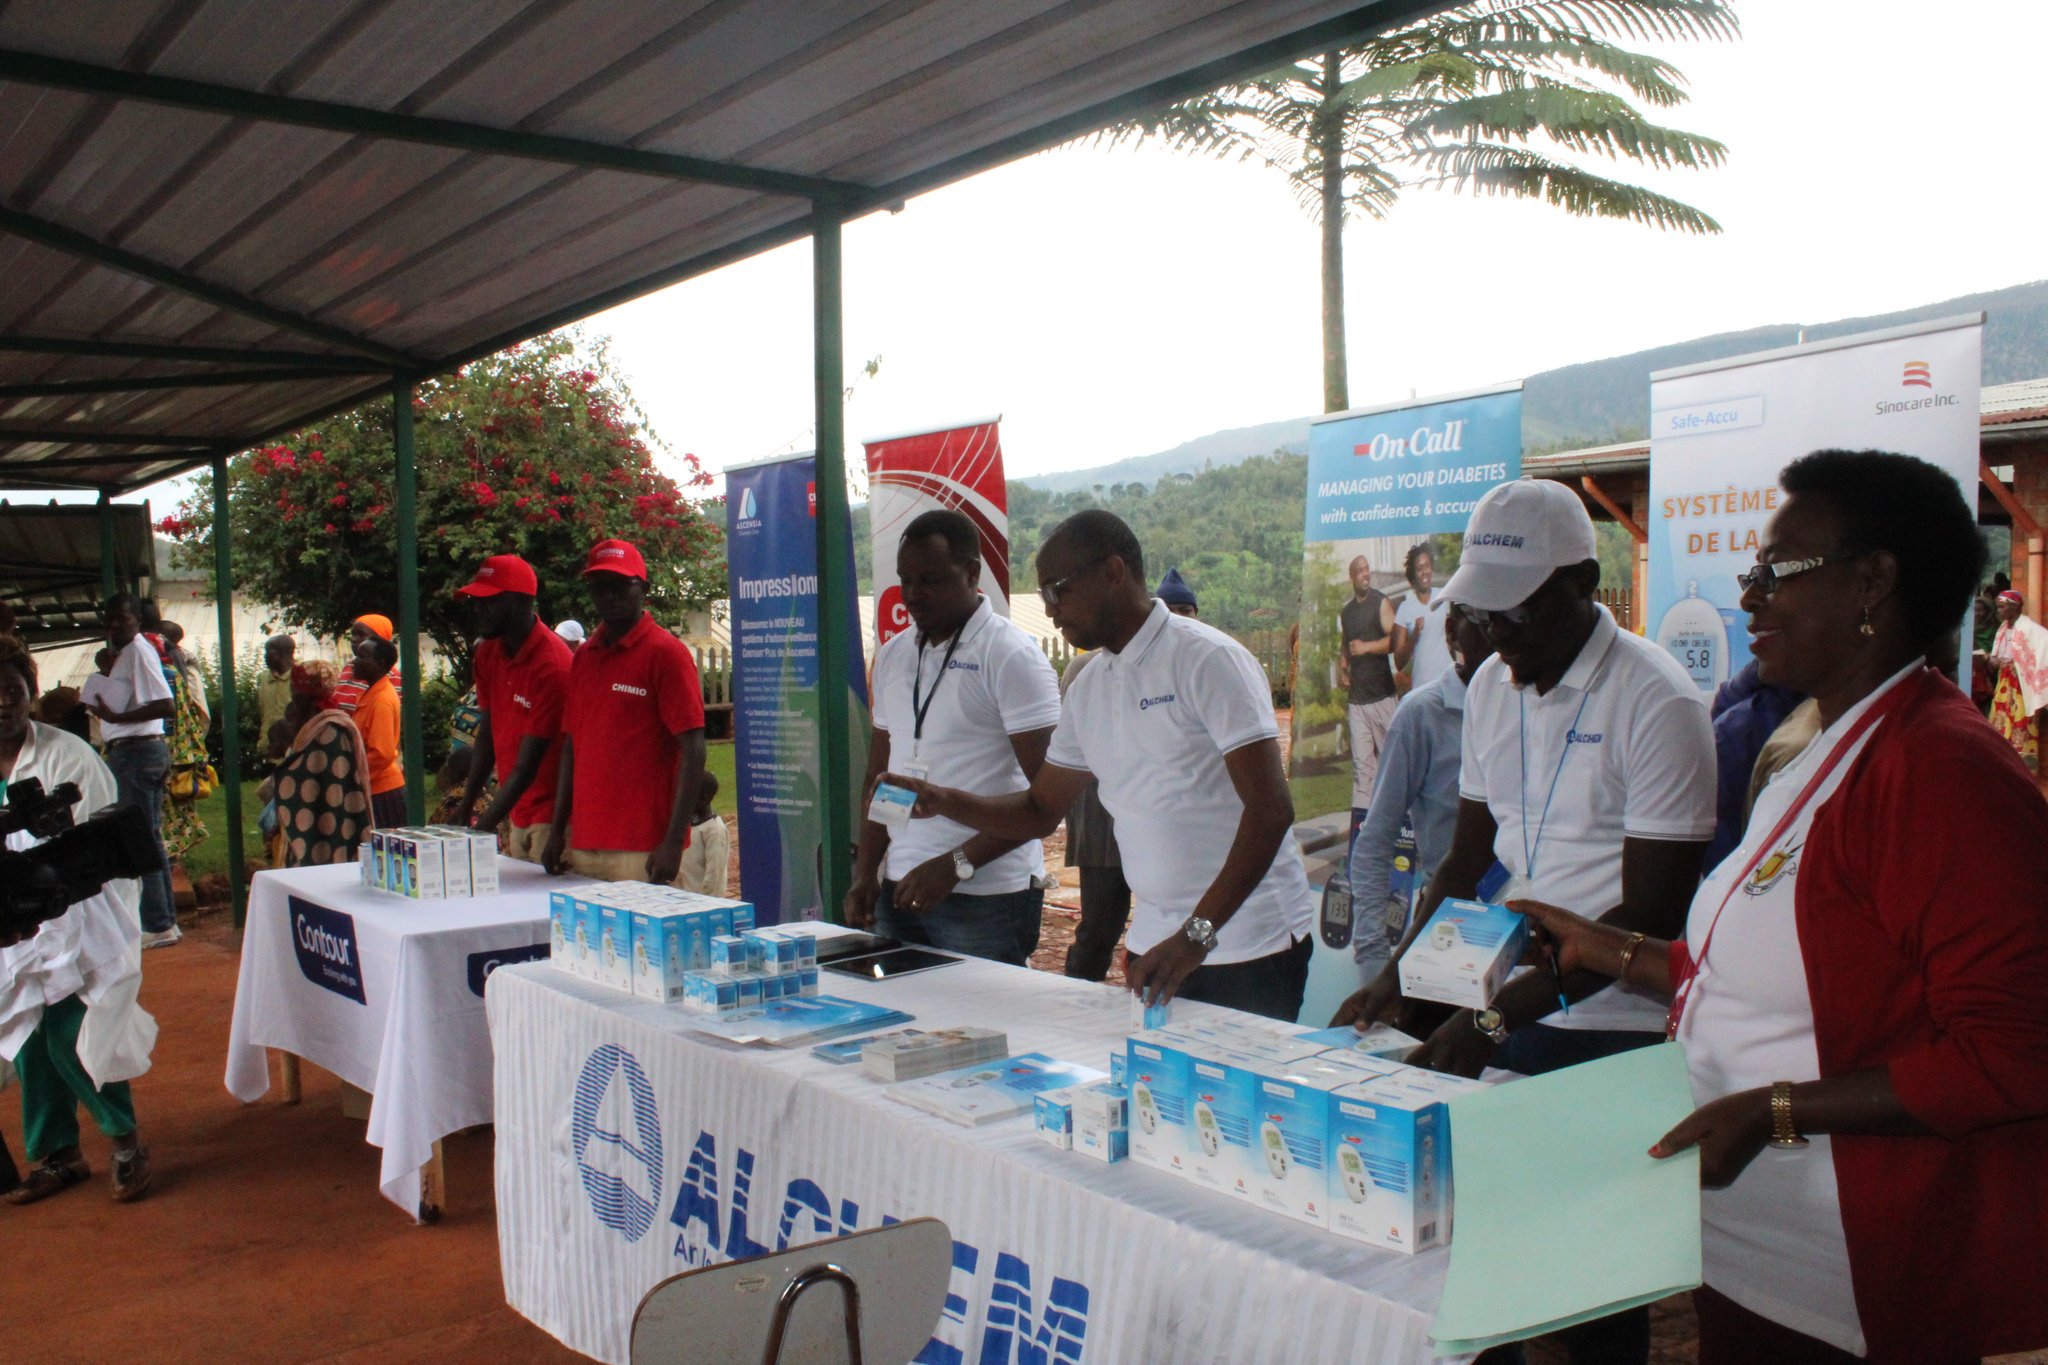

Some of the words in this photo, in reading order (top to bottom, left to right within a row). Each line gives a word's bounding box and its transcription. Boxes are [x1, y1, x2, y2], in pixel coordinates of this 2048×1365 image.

[1875, 397, 1932, 416] Sinocare
[1935, 393, 1960, 407] Inc.
[1671, 410, 1738, 430] Safe-Accu
[1369, 432, 1406, 462] On
[1408, 419, 1464, 457] Call
[1317, 475, 1393, 498] MANAGING
[1397, 472, 1434, 490] YOUR
[1437, 462, 1506, 486] DIABETES
[1320, 507, 1347, 524] with
[1351, 502, 1419, 523] confidence
[1424, 500, 1432, 516] &
[1663, 486, 1777, 519] SYSTÈME
[736, 520, 762, 530] ASCENSIA
[1472, 533, 1525, 549] ALCHEM
[1688, 532, 1719, 554] DE
[1729, 529, 1760, 552] LA
[1686, 649, 1710, 669] 5.8
[612, 683, 647, 697] CHIMIO
[297, 913, 350, 966] Contour
